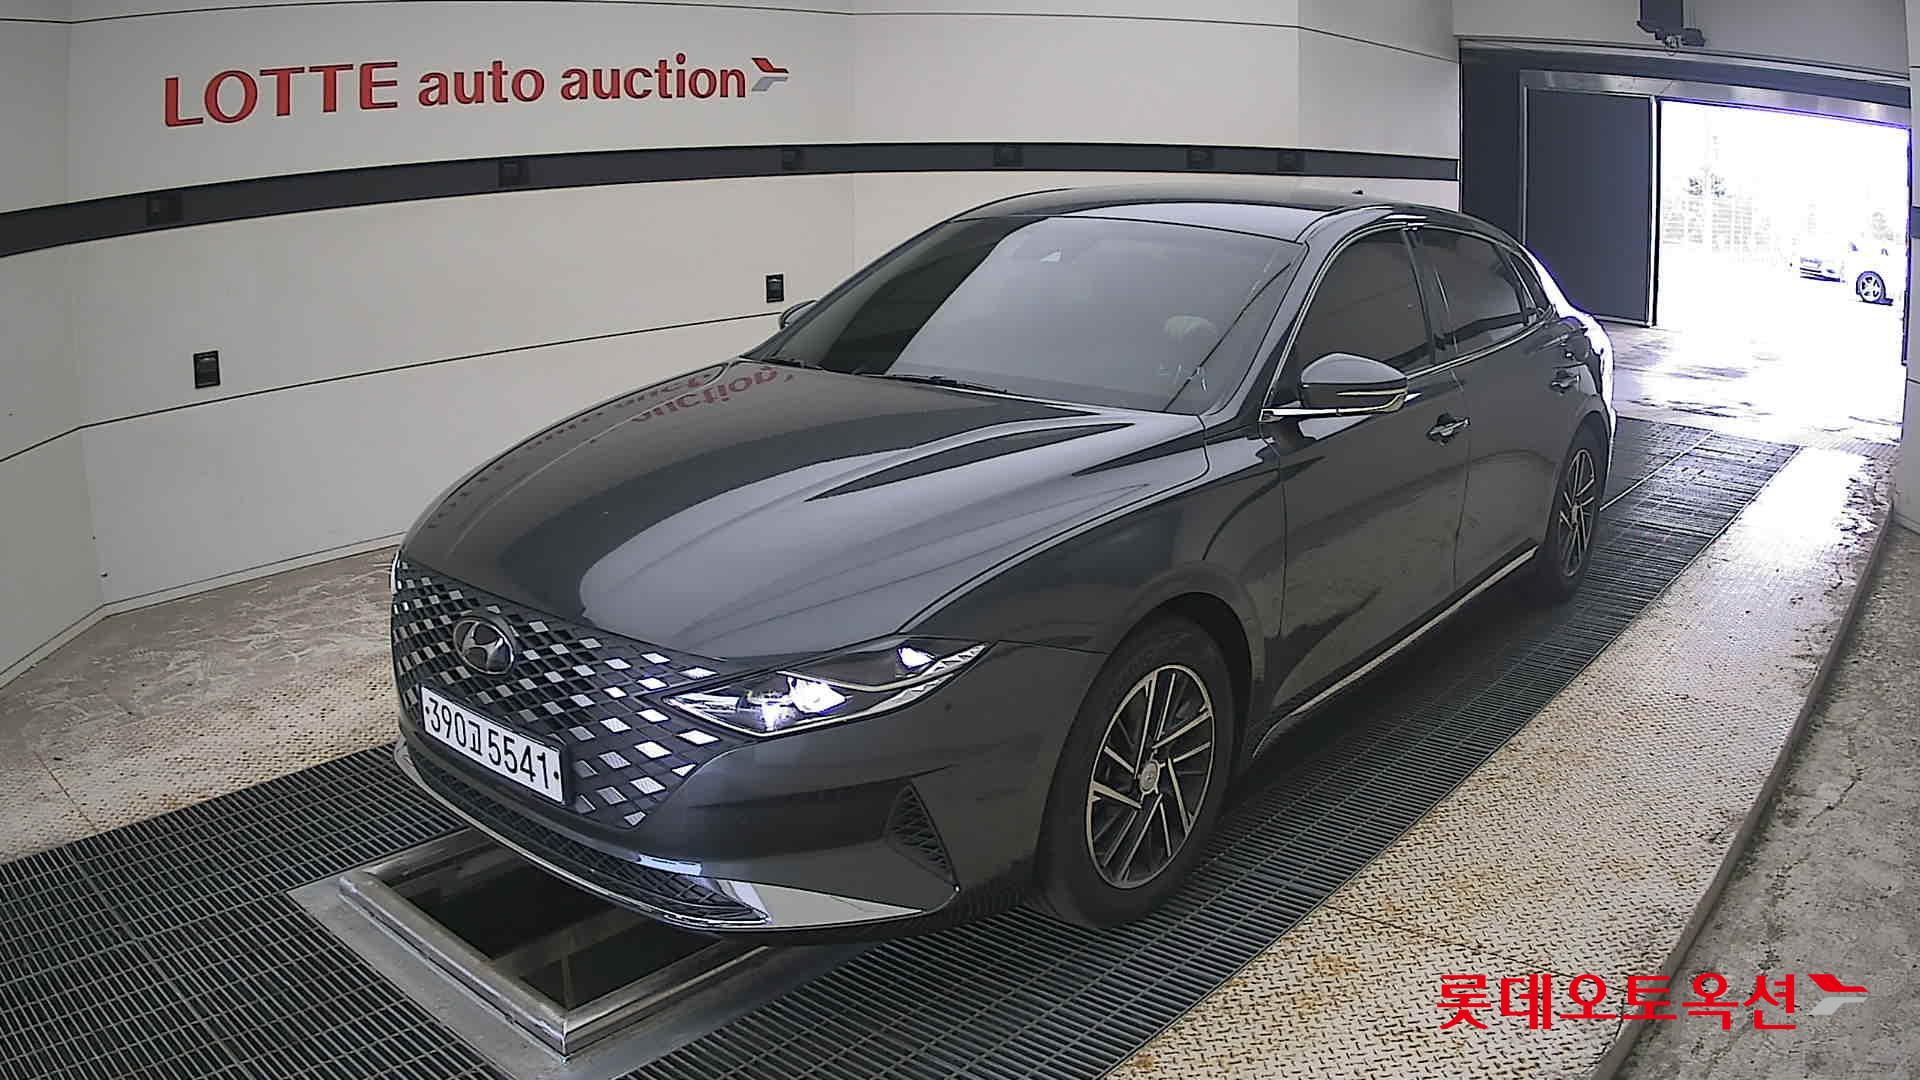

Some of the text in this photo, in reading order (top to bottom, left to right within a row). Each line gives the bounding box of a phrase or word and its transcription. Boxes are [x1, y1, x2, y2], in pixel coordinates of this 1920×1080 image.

[164, 53, 747, 128] LOTTE auto auction
